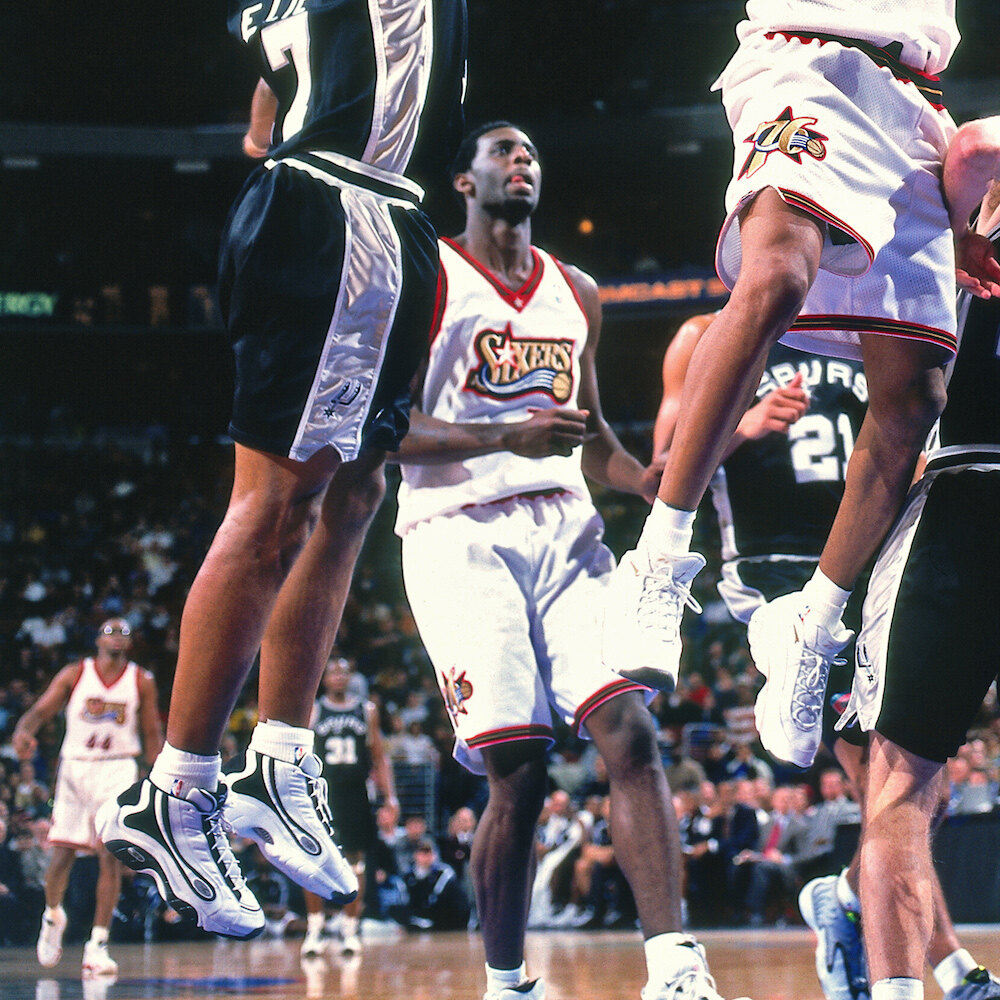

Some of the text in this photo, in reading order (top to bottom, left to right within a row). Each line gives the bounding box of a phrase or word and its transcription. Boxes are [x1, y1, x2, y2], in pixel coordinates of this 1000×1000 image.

[260, 10, 312, 144] 7
[788, 413, 854, 484] 21
[86, 733, 113, 751] 44
[325, 736, 358, 765] 31
